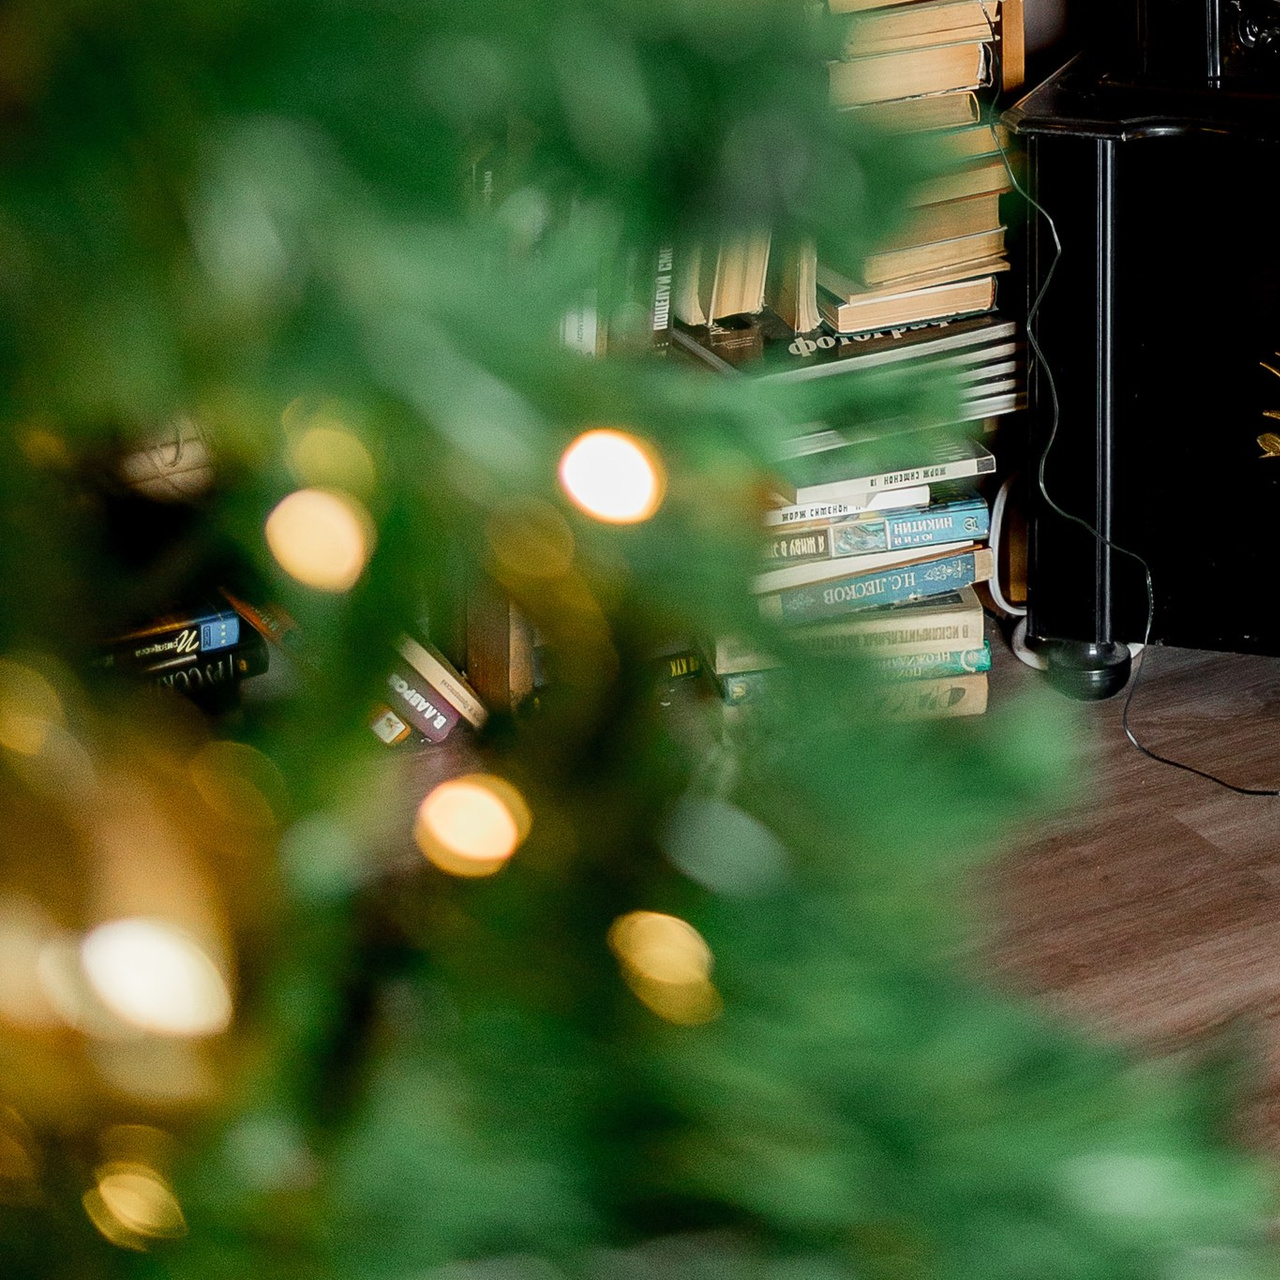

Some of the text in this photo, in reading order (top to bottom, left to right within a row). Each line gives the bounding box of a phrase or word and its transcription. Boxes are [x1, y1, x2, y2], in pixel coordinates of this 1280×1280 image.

[653, 274, 672, 331] ПОЦЕЛУЙ
[884, 471, 920, 485] СИМЕНОН
[781, 504, 849, 522] ЖОРЖ СИМЕНОН
[893, 517, 953, 535] НИКИТИН
[789, 534, 826, 554] Я ЖИВУ
[893, 533, 933, 546] ЮРИЙ
[823, 572, 917, 605] Н.С. ЛЕСКОВ
